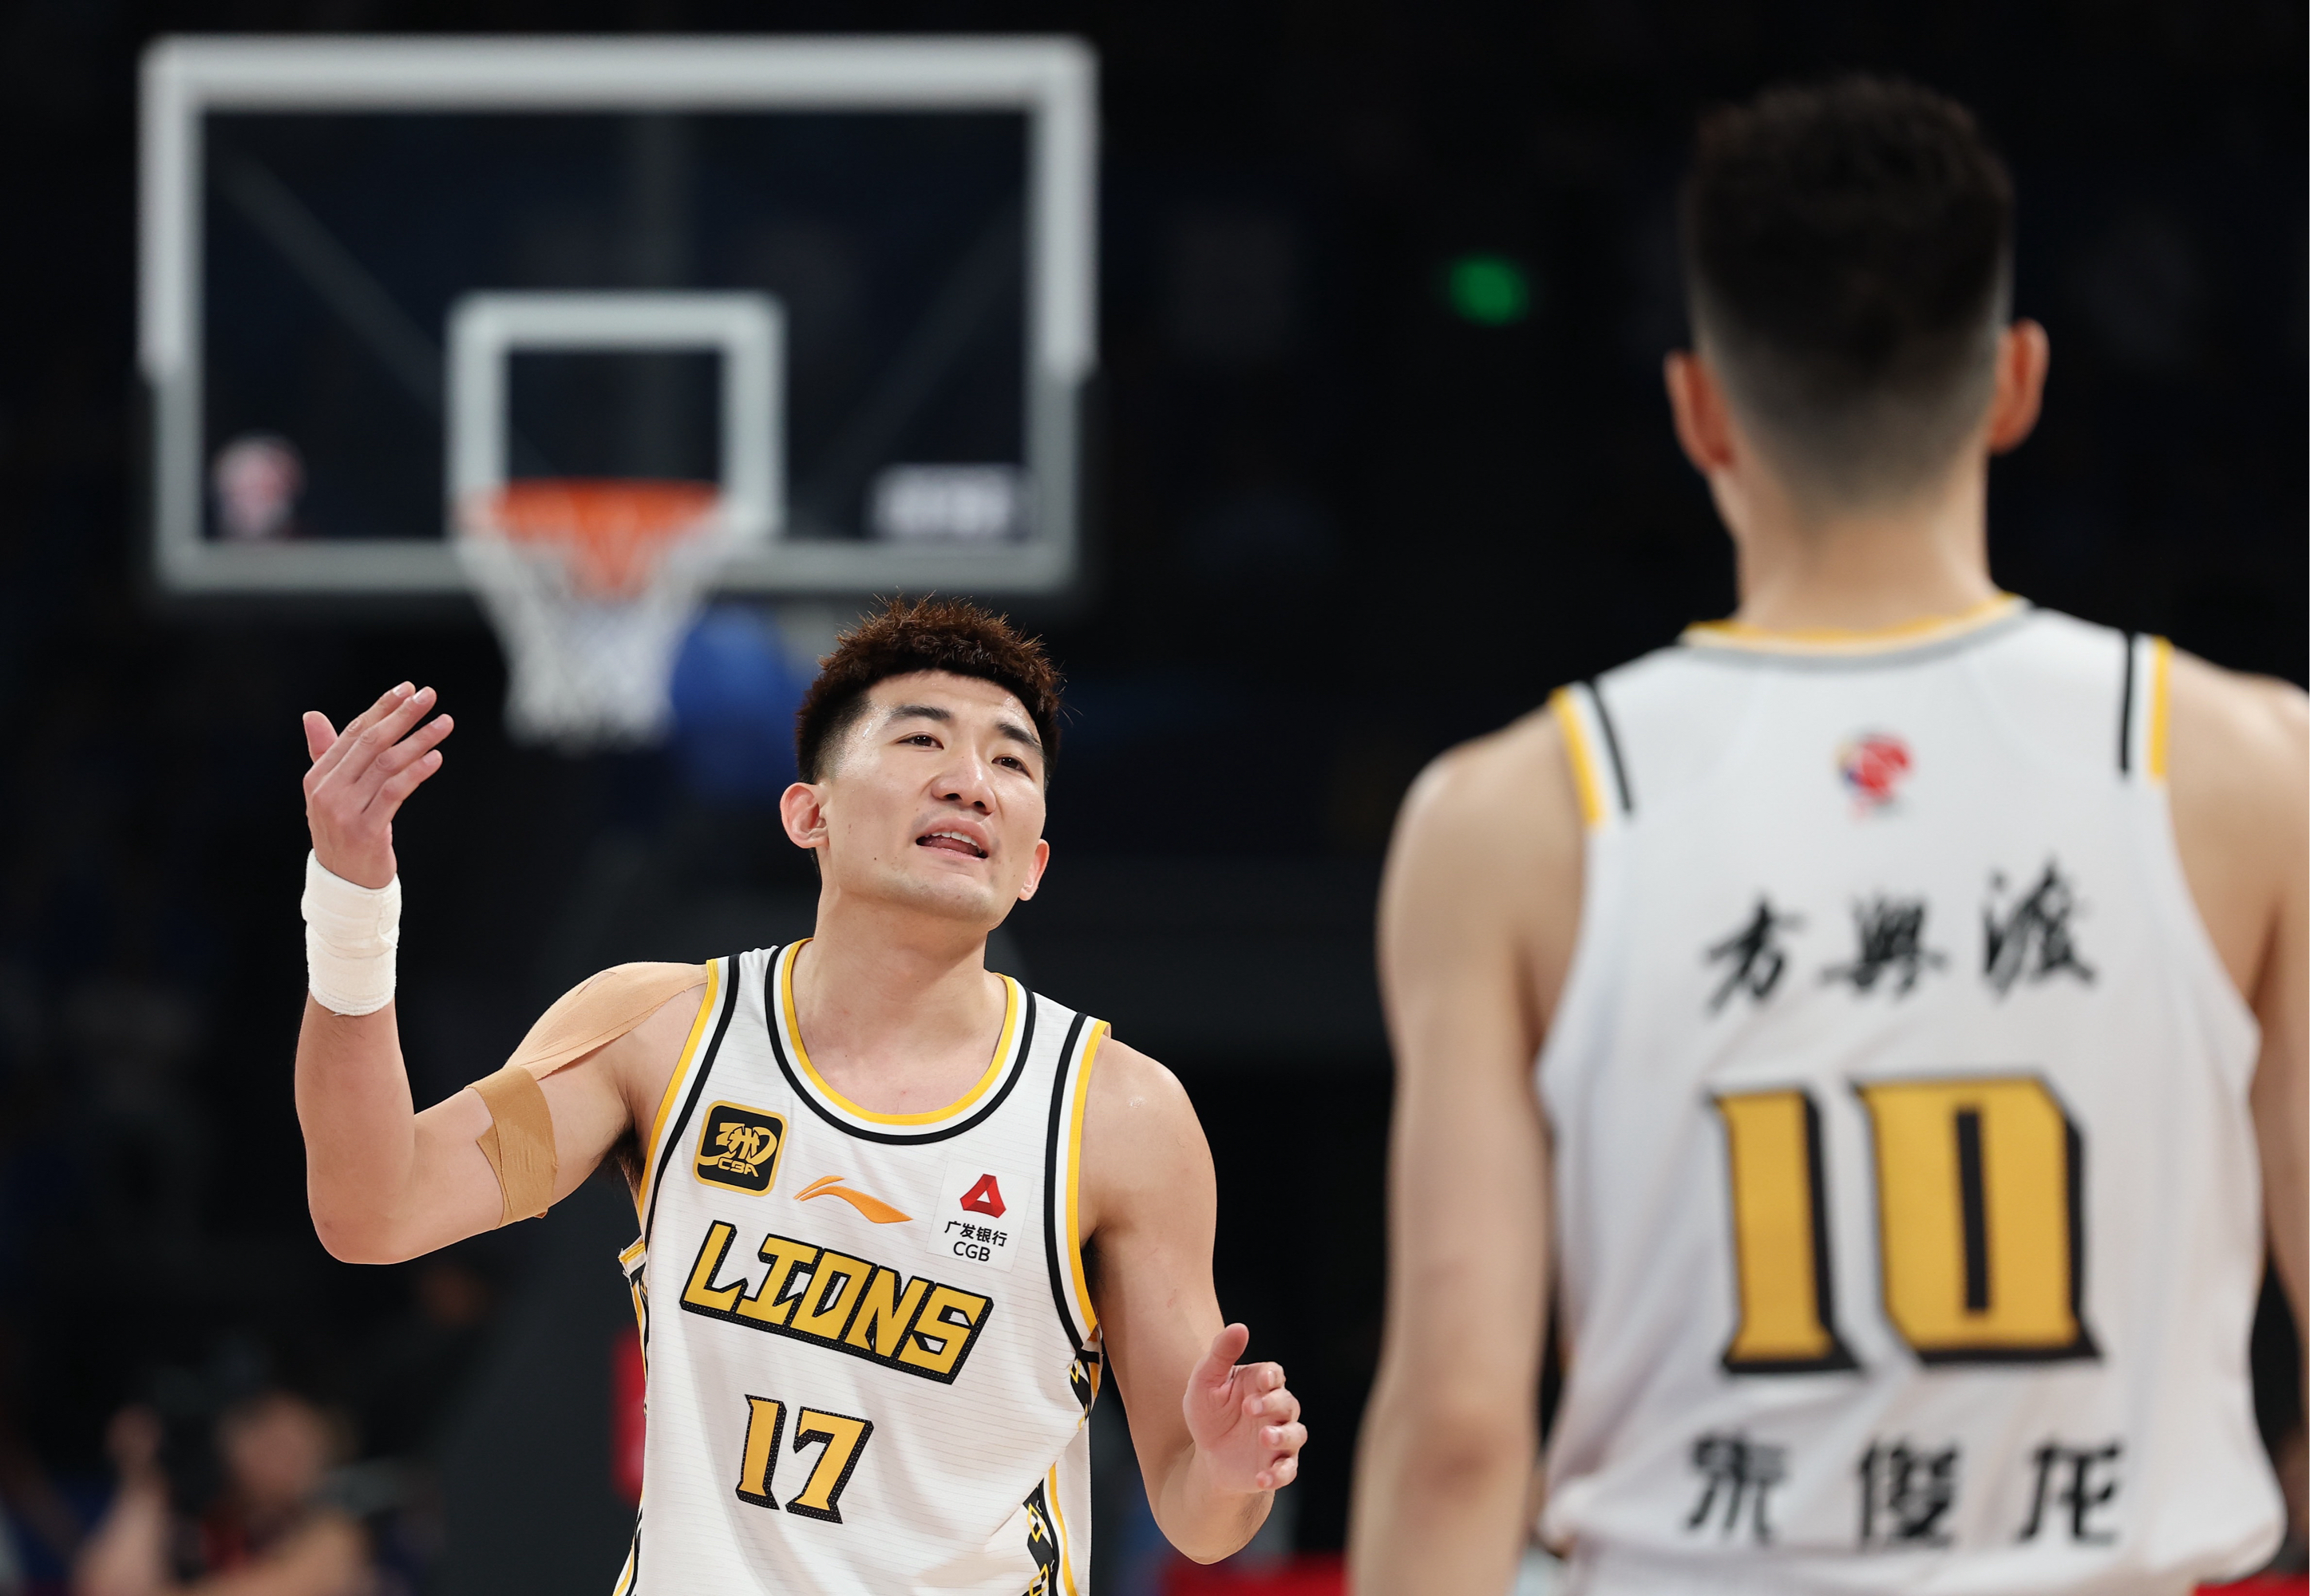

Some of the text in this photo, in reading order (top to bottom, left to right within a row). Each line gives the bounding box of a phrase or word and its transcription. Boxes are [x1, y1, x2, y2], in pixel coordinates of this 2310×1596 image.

[718, 1158, 759, 1178] CBA
[944, 1220, 1008, 1247] 广发银行
[953, 1242, 991, 1262] CGB
[1702, 1074, 2102, 1374] 10
[679, 1220, 994, 1385] LIONS
[735, 1394, 874, 1523] 17
